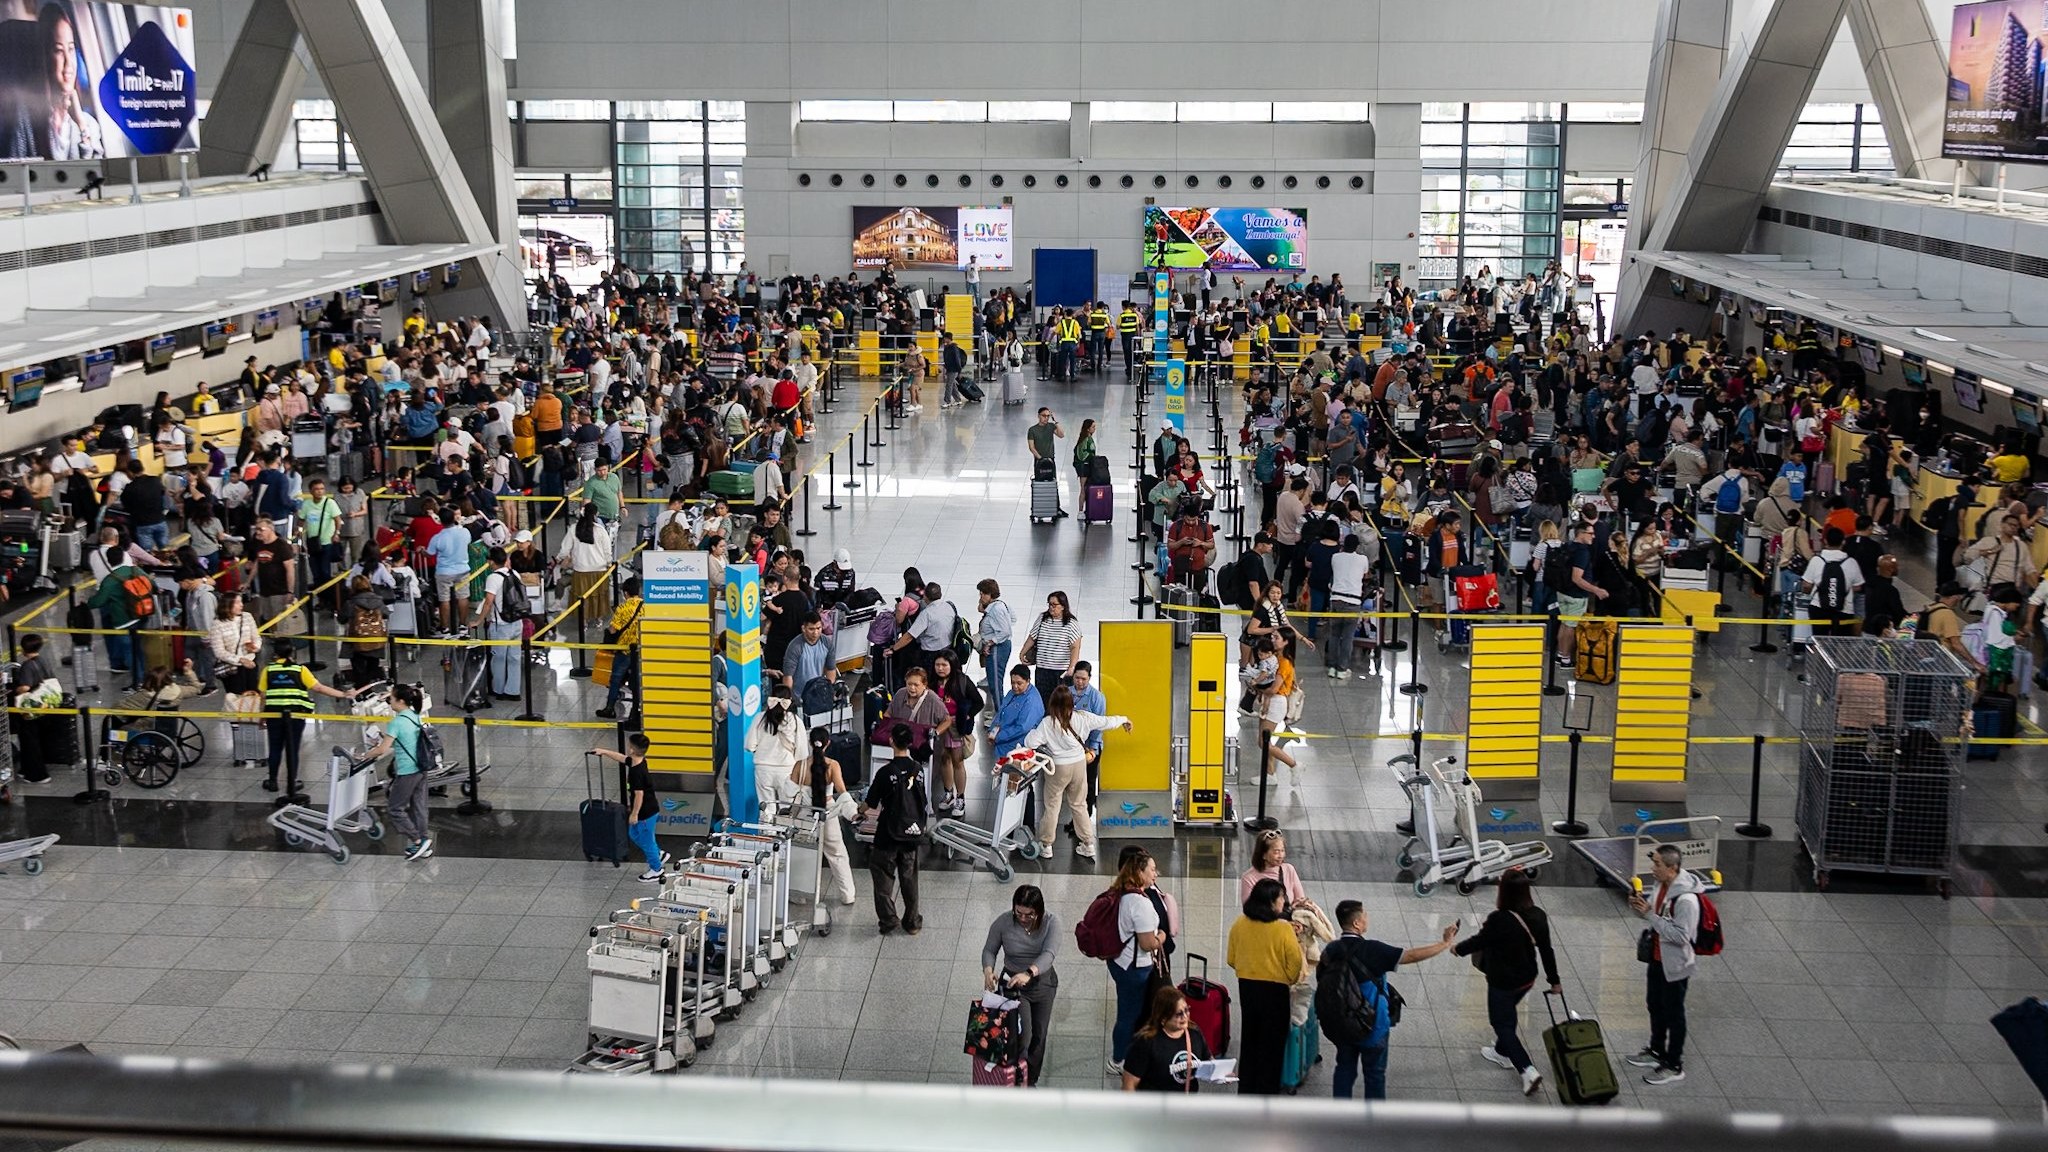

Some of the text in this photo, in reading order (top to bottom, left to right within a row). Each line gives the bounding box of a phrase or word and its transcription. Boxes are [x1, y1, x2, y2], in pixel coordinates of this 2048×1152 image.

[125, 65, 153, 91] mile
[119, 95, 185, 110] foreign currency spend
[1960, 109, 1976, 118] where
[1991, 109, 2003, 118] and
[2002, 109, 2017, 121] play
[1242, 213, 1303, 228] Vamos a
[964, 223, 1007, 236] LOVE
[1245, 229, 1301, 242] Zamboanga!
[856, 258, 875, 266] CALLE
[1173, 375, 1179, 386] 2
[673, 565, 695, 574] pacific
[651, 584, 686, 592] Passengers
[677, 592, 703, 600] Mobility
[731, 595, 737, 613] 3
[748, 595, 754, 613] 3
[669, 813, 708, 827] pacific
[1101, 815, 1169, 829] cebu pacific
[1478, 823, 1500, 833] ebu
